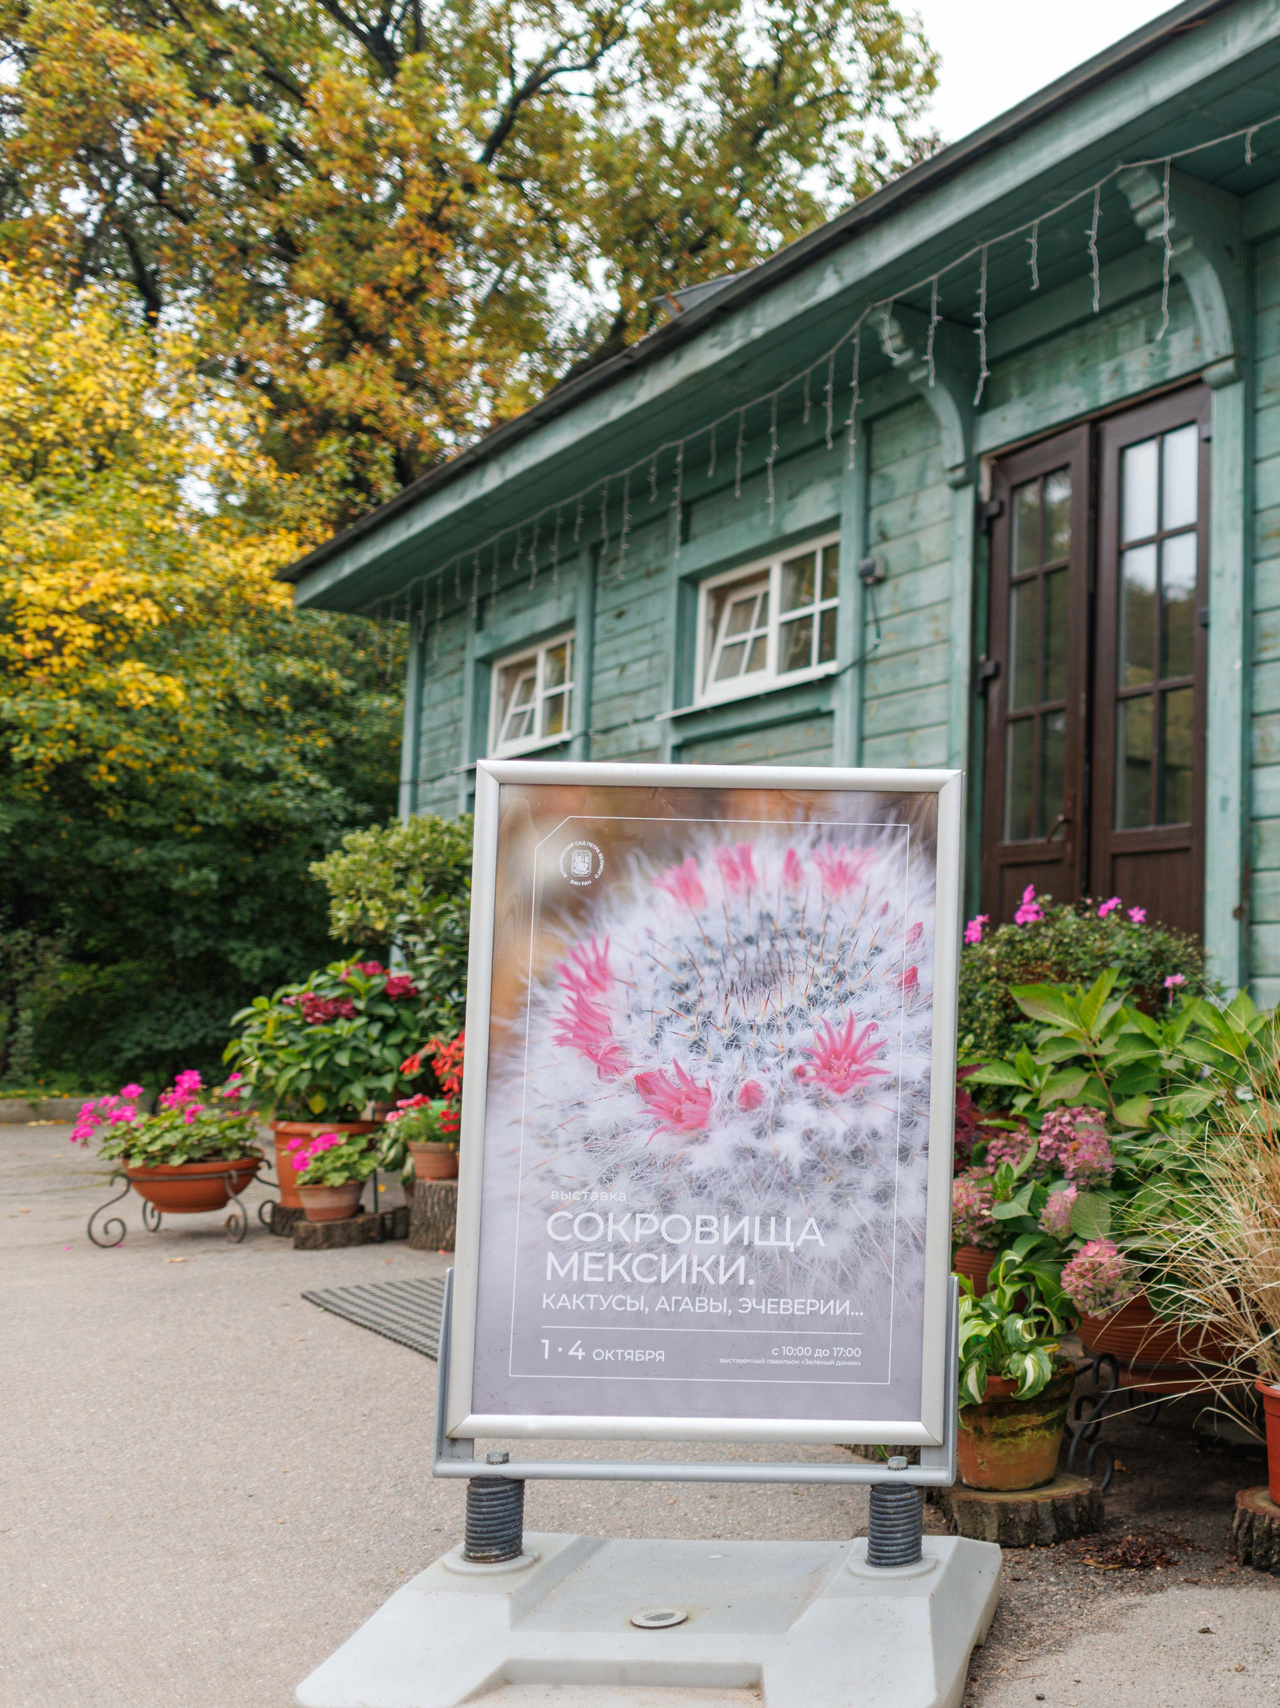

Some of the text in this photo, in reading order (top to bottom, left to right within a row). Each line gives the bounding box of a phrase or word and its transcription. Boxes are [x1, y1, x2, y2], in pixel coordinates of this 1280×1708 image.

[550, 1190, 627, 1202] выставка
[546, 1211, 826, 1253] СОКРОВИЩА
[546, 1251, 755, 1286] МЕКСИКИ.
[542, 1293, 650, 1314] КАКТУСЫ,
[655, 1296, 732, 1316] АГАВЫ,
[592, 1348, 666, 1362] ОКТЯБРЯ
[781, 1346, 812, 1357] 10:00
[814, 1348, 830, 1358] до
[832, 1347, 862, 1358] 17:00
[719, 1357, 766, 1365] выставочный
[766, 1358, 800, 1366] павильон
